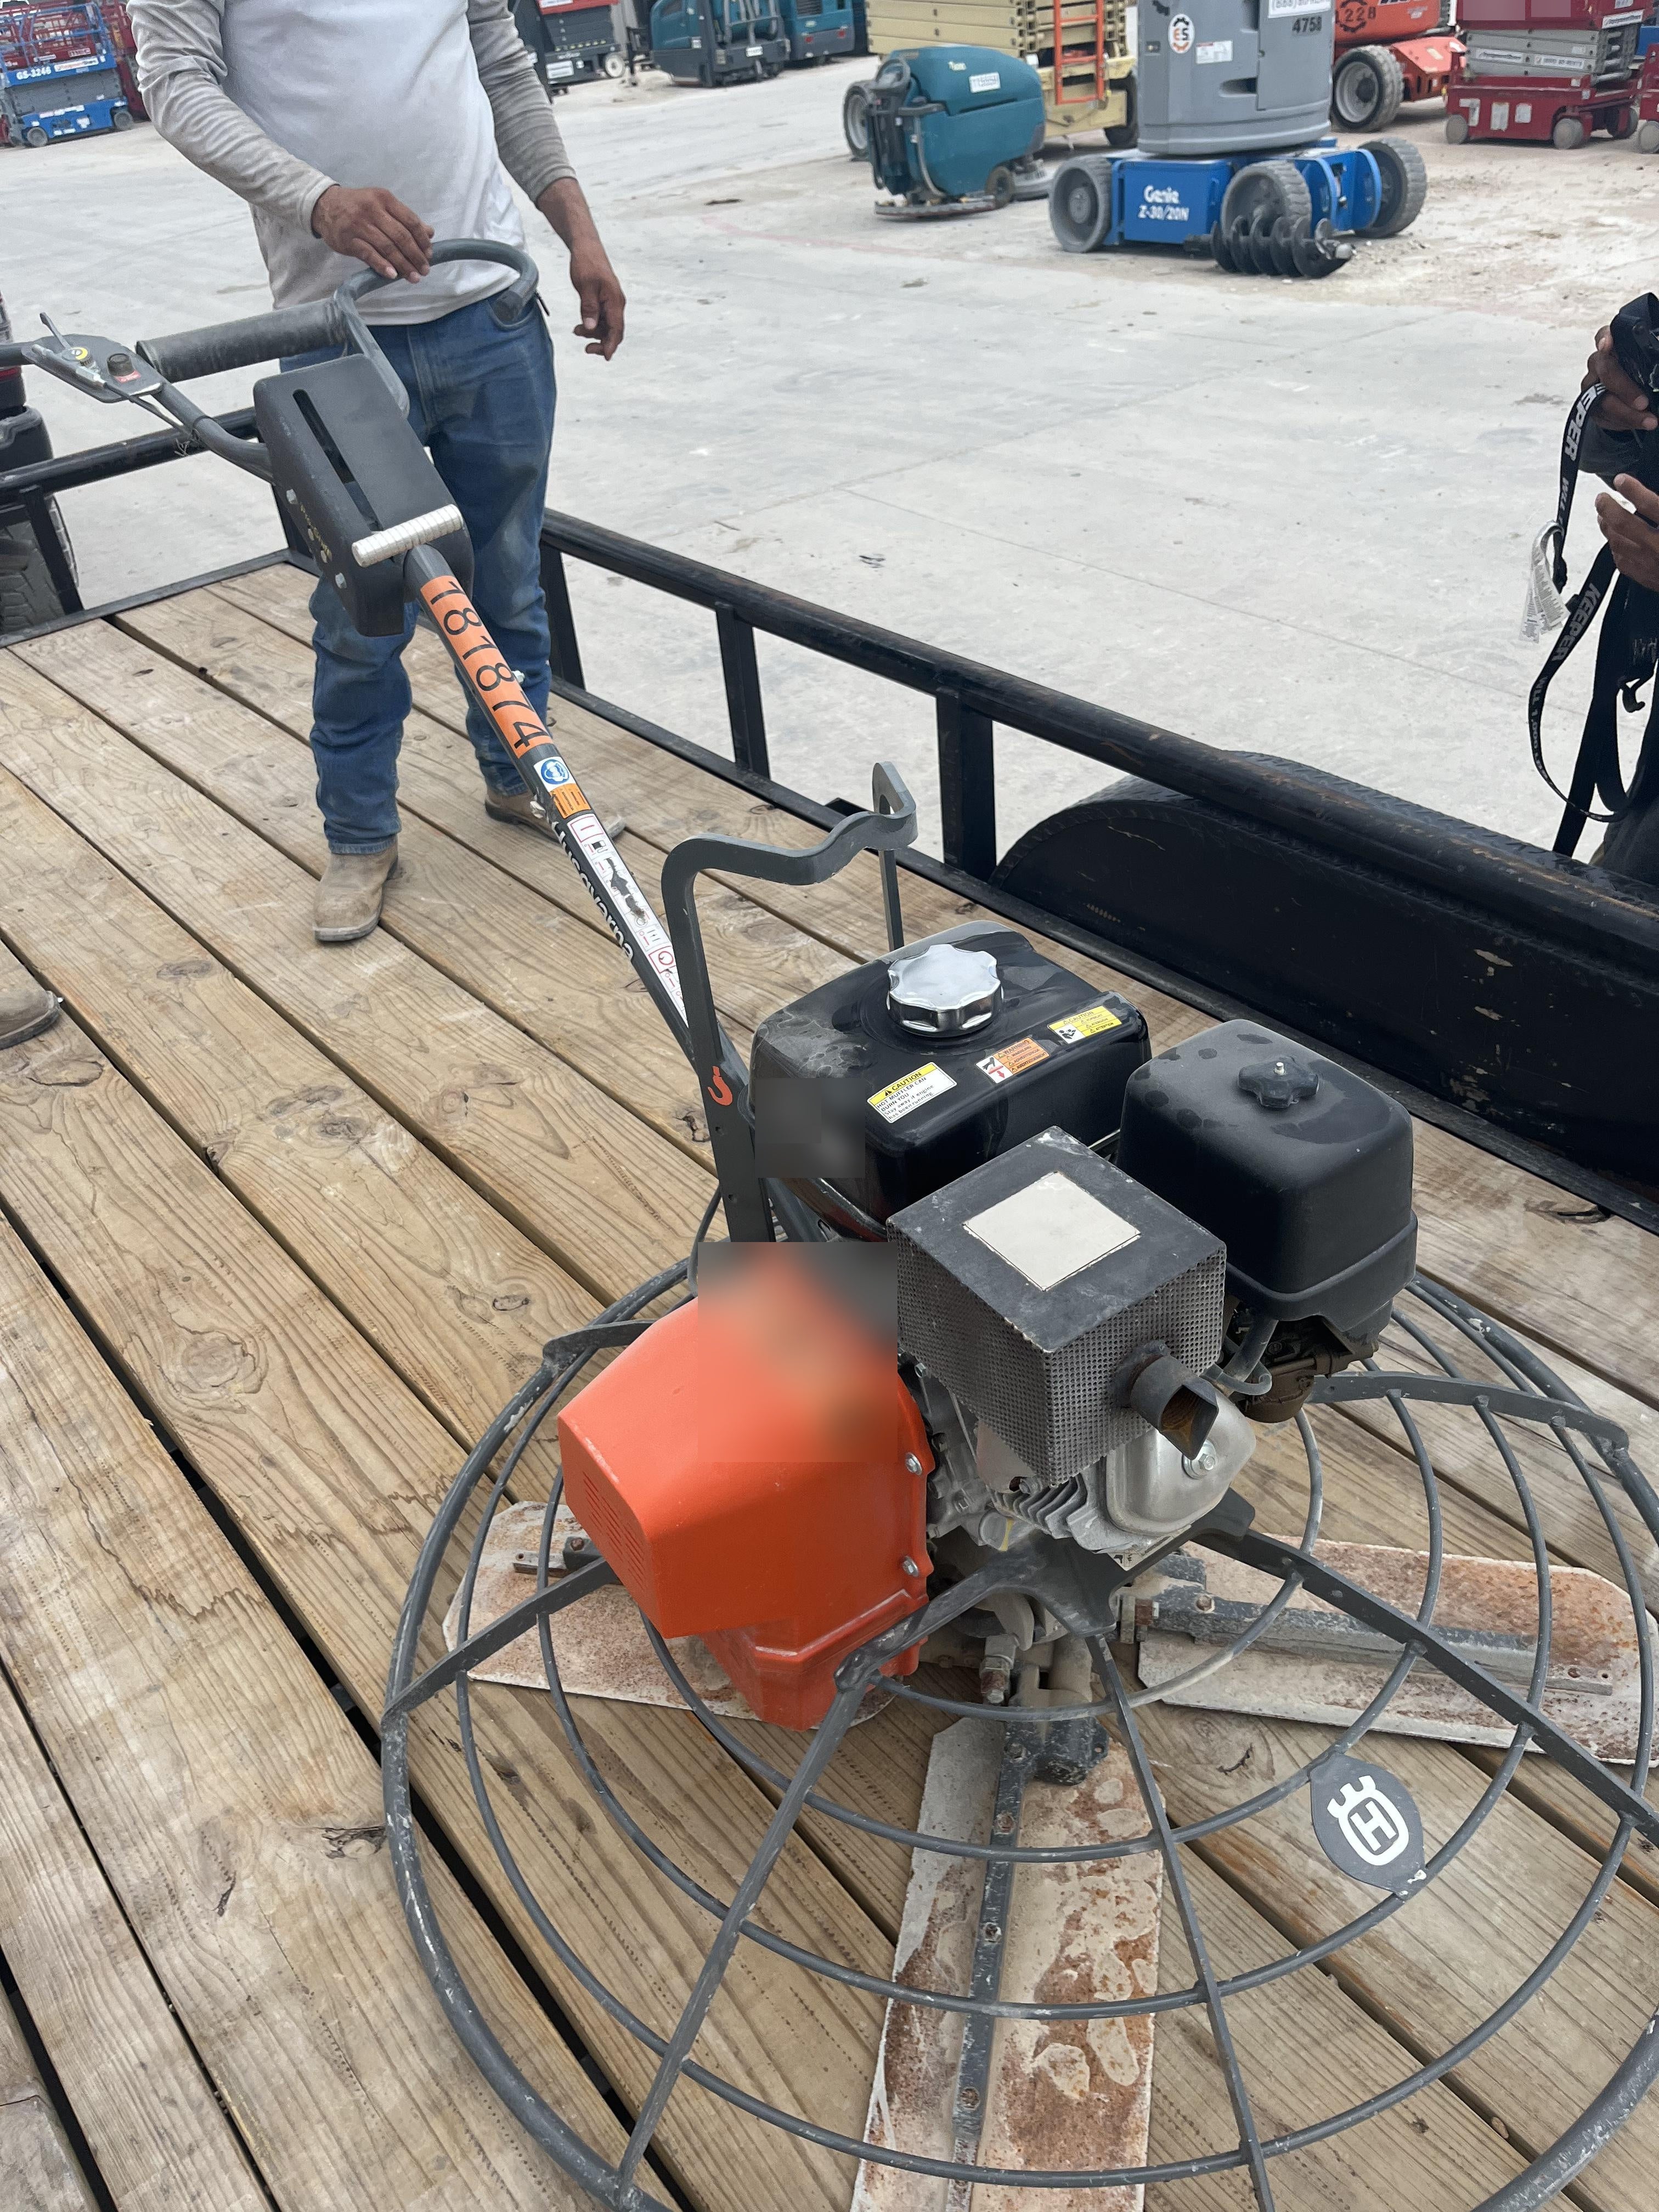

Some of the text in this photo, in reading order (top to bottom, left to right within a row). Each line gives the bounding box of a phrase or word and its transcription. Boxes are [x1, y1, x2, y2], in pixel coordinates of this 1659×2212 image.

[1143, 184, 1180, 204] Genie
[1565, 382, 1606, 461] EEPER
[1551, 583, 1601, 662] KEEPER
[550, 821, 634, 961] Hqvarna
[1069, 1011, 1094, 1023] CAUTION
[877, 1077, 927, 1109] HOT MUFFLER CAN
[892, 1072, 922, 1091] CAUTION
[881, 1093, 909, 1111] BURN YOU
[884, 1107, 896, 1115] Stay
[898, 1099, 911, 1108] away
[916, 1085, 934, 1097] engine
[899, 1103, 912, 1113] been
